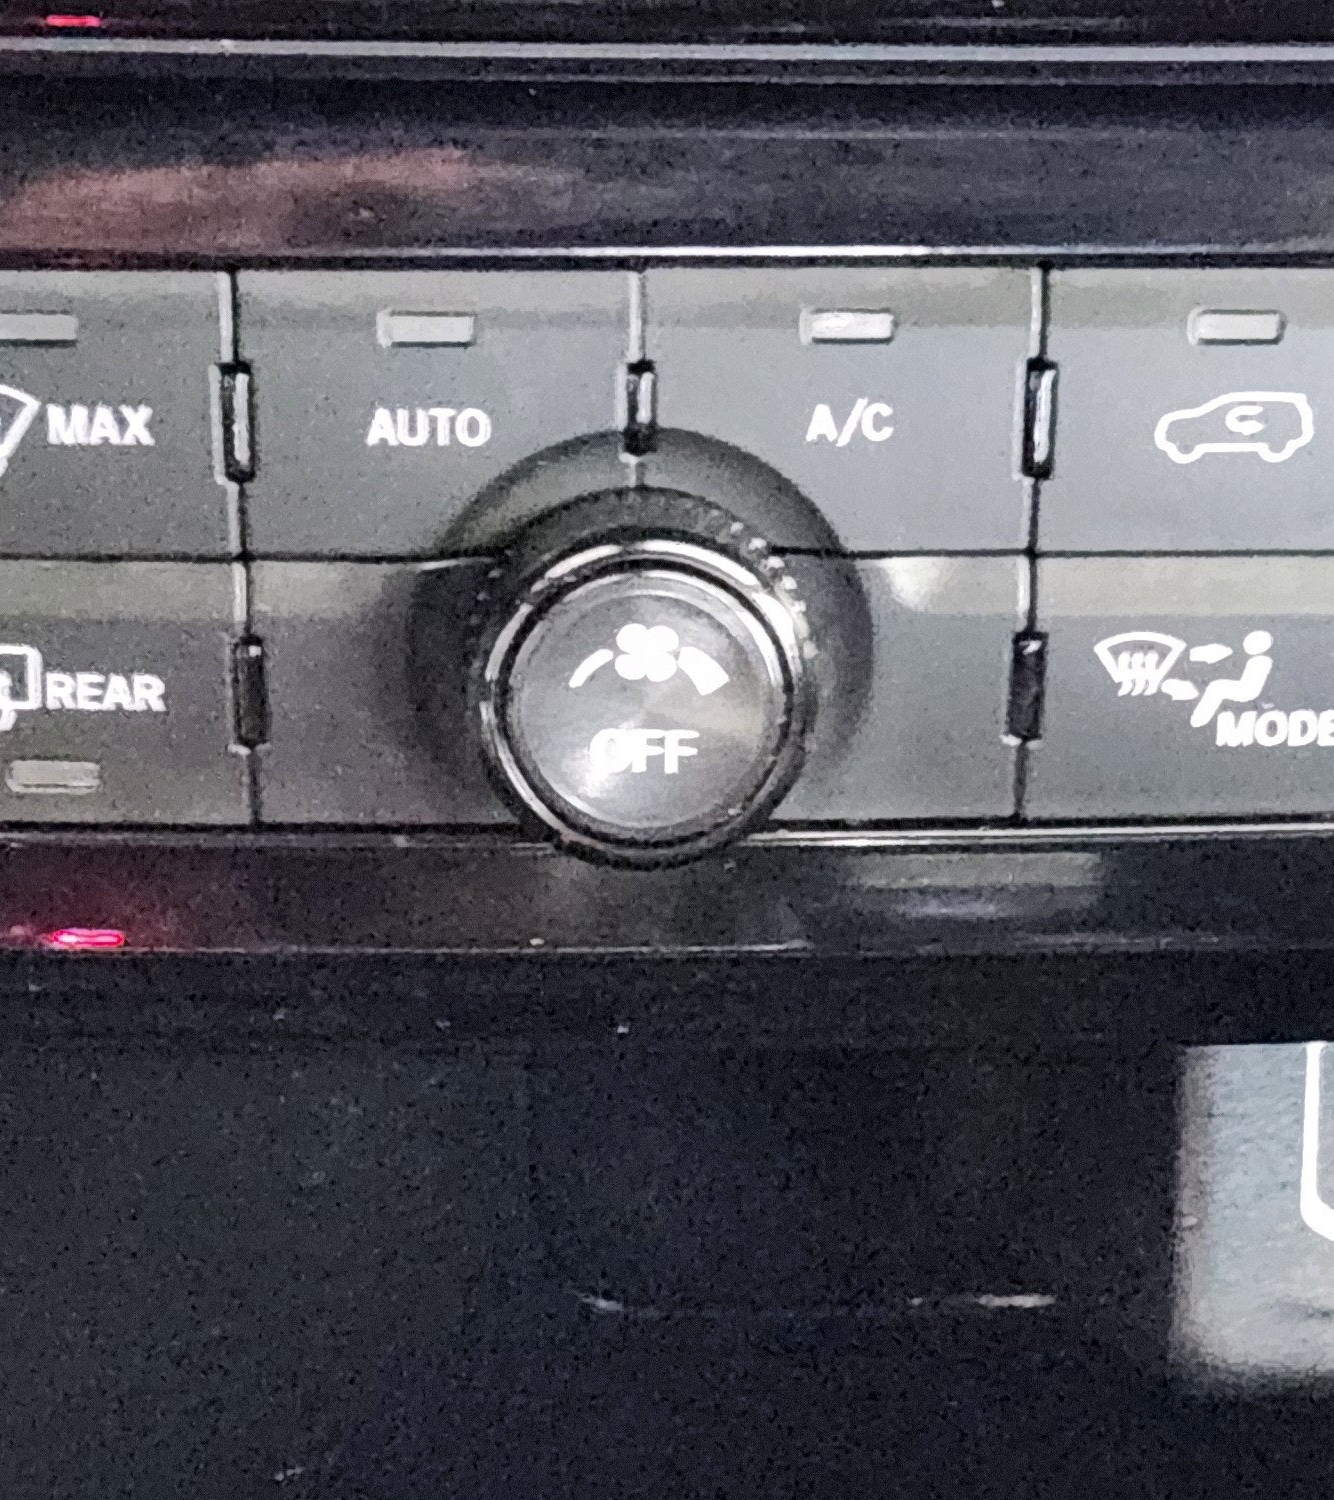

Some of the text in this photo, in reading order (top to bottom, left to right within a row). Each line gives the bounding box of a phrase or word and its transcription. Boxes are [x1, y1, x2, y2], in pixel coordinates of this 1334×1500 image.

[45, 402, 156, 446] MAX
[365, 406, 492, 448] AUTO
[805, 397, 895, 448] A/C
[45, 671, 168, 713] REAR
[589, 727, 701, 776] OFF
